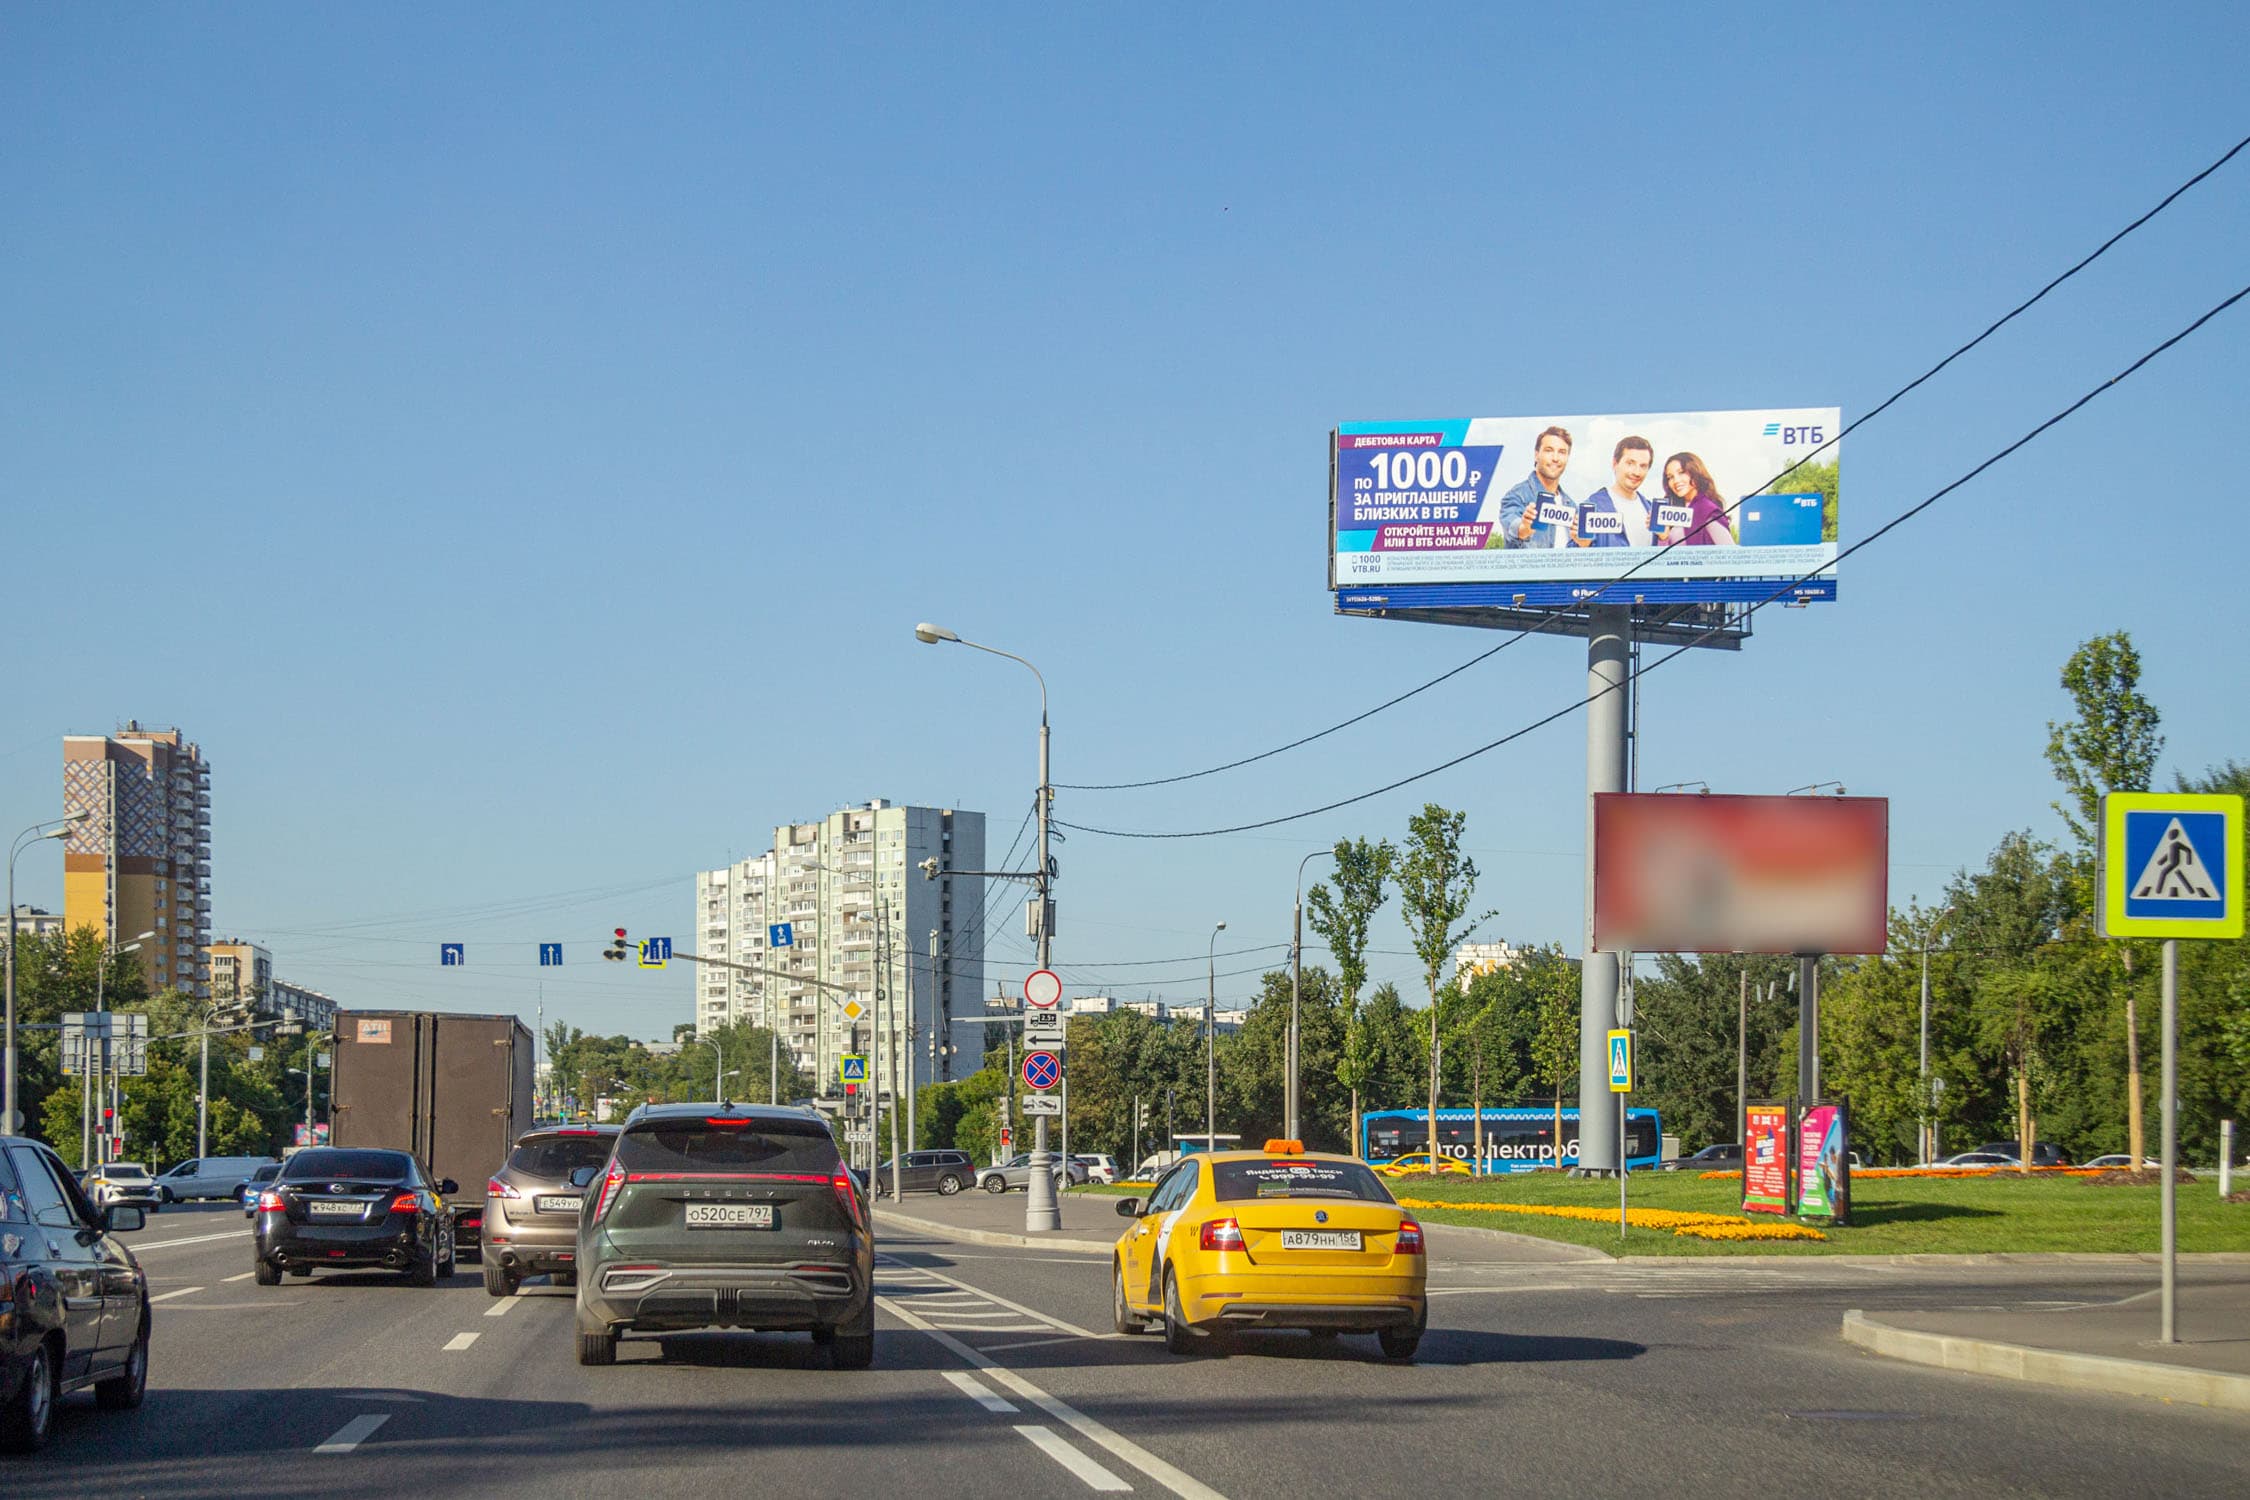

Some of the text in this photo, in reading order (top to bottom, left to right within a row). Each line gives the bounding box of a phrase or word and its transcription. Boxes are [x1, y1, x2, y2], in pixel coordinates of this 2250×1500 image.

[1354, 435, 1436, 448] ДЕБЕТОВАЯ КАРТА
[1783, 426, 1824, 444] ВТБ
[1354, 490, 1477, 505] ЗА ПРИГЛАШЕНИЕ
[1354, 506, 1459, 521] БЛИЗКИХ В ВТБ
[1384, 524, 1487, 537] ОТКРОЙТЕ НА VTB.RU
[1384, 534, 1478, 548] ИЛИ В ВТБ ОНЛАЙН
[1359, 554, 1381, 564] 1000
[1352, 564, 1381, 573] VTB.RU
[748, 1207, 769, 1218] 797
[1287, 1233, 1357, 1246] А879НН 156
